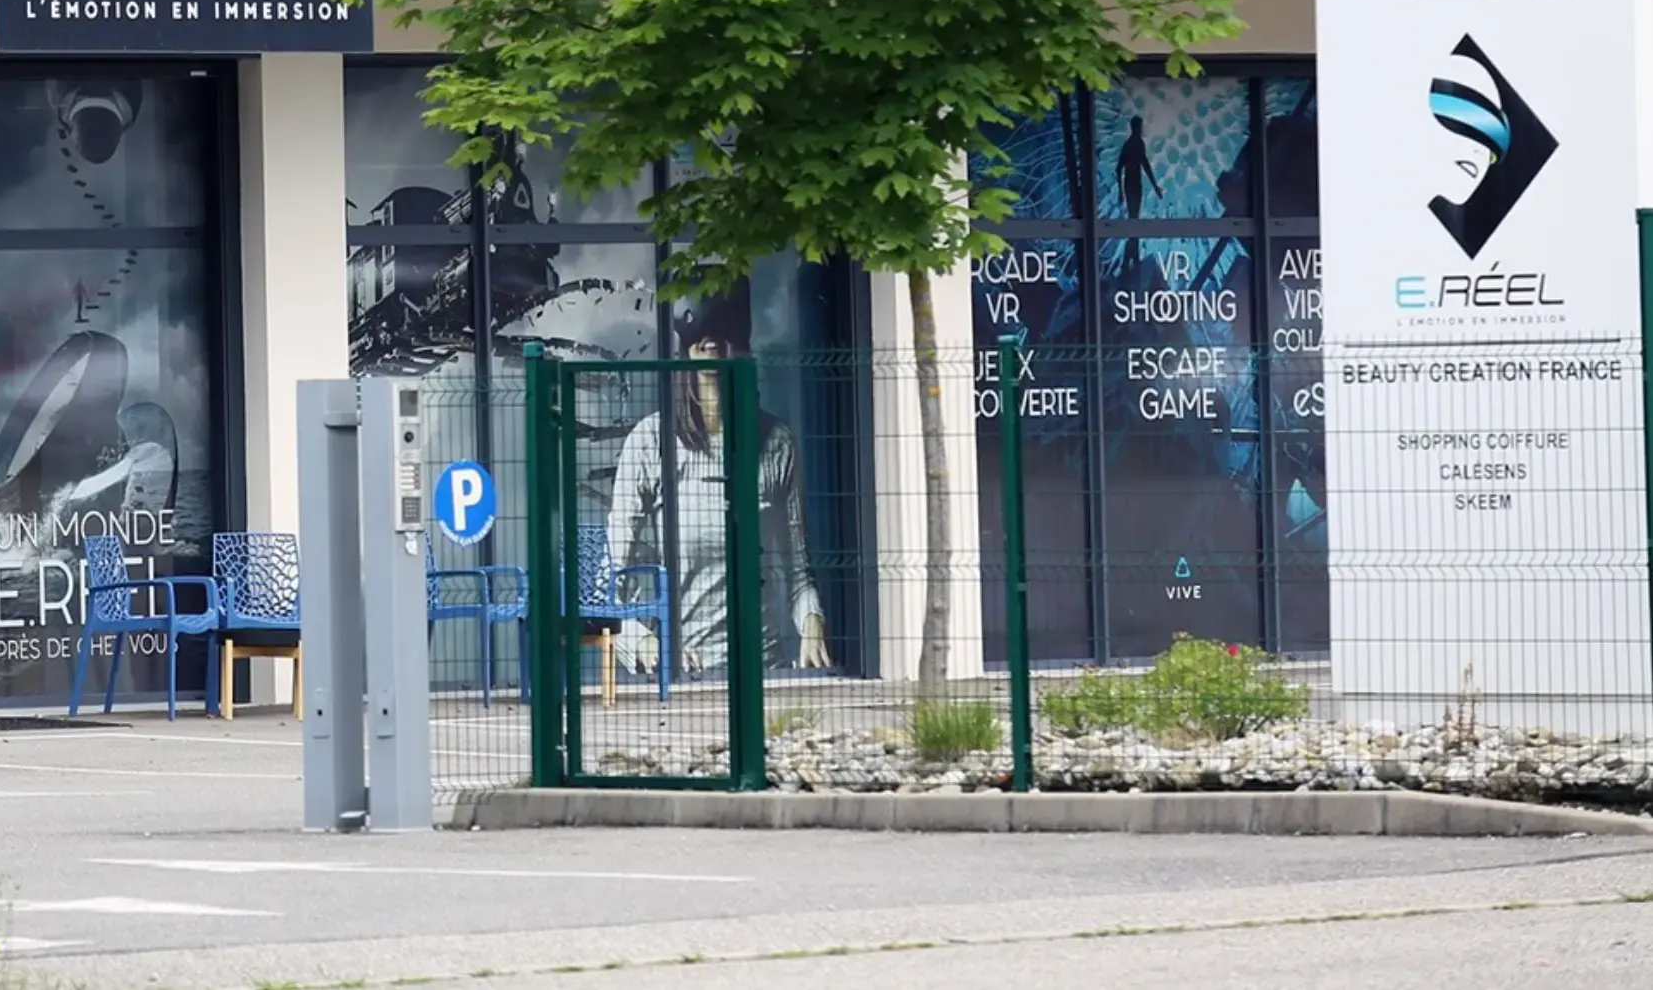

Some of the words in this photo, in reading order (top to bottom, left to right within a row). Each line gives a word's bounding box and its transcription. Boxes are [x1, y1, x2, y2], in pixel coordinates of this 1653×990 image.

[173, 2, 199, 19] EN
[215, 2, 349, 20] IMMERSION
[969, 251, 1058, 283] RCADE
[1156, 251, 1191, 282] VR
[1279, 249, 1322, 280] AVE
[1396, 261, 1564, 308] E.RÉEL
[985, 293, 1021, 324] VR
[1114, 291, 1237, 323] SHOOTING
[1284, 289, 1323, 320] VIR
[1128, 347, 1227, 380] ESCAPE
[1343, 364, 1422, 384] BEAUTY
[1539, 360, 1622, 381] FRANCE
[1140, 387, 1217, 419] GAME
[1293, 382, 1326, 417] eS
[1397, 434, 1481, 450] SHOPPING
[1486, 433, 1570, 450] COIFFURE
[451, 469, 483, 531] P
[1455, 494, 1512, 510] SKEEM
[52, 510, 175, 547] MONDE
[1166, 585, 1202, 600] VIVE
[47, 638, 71, 659] DE
[129, 632, 178, 655] VOU
